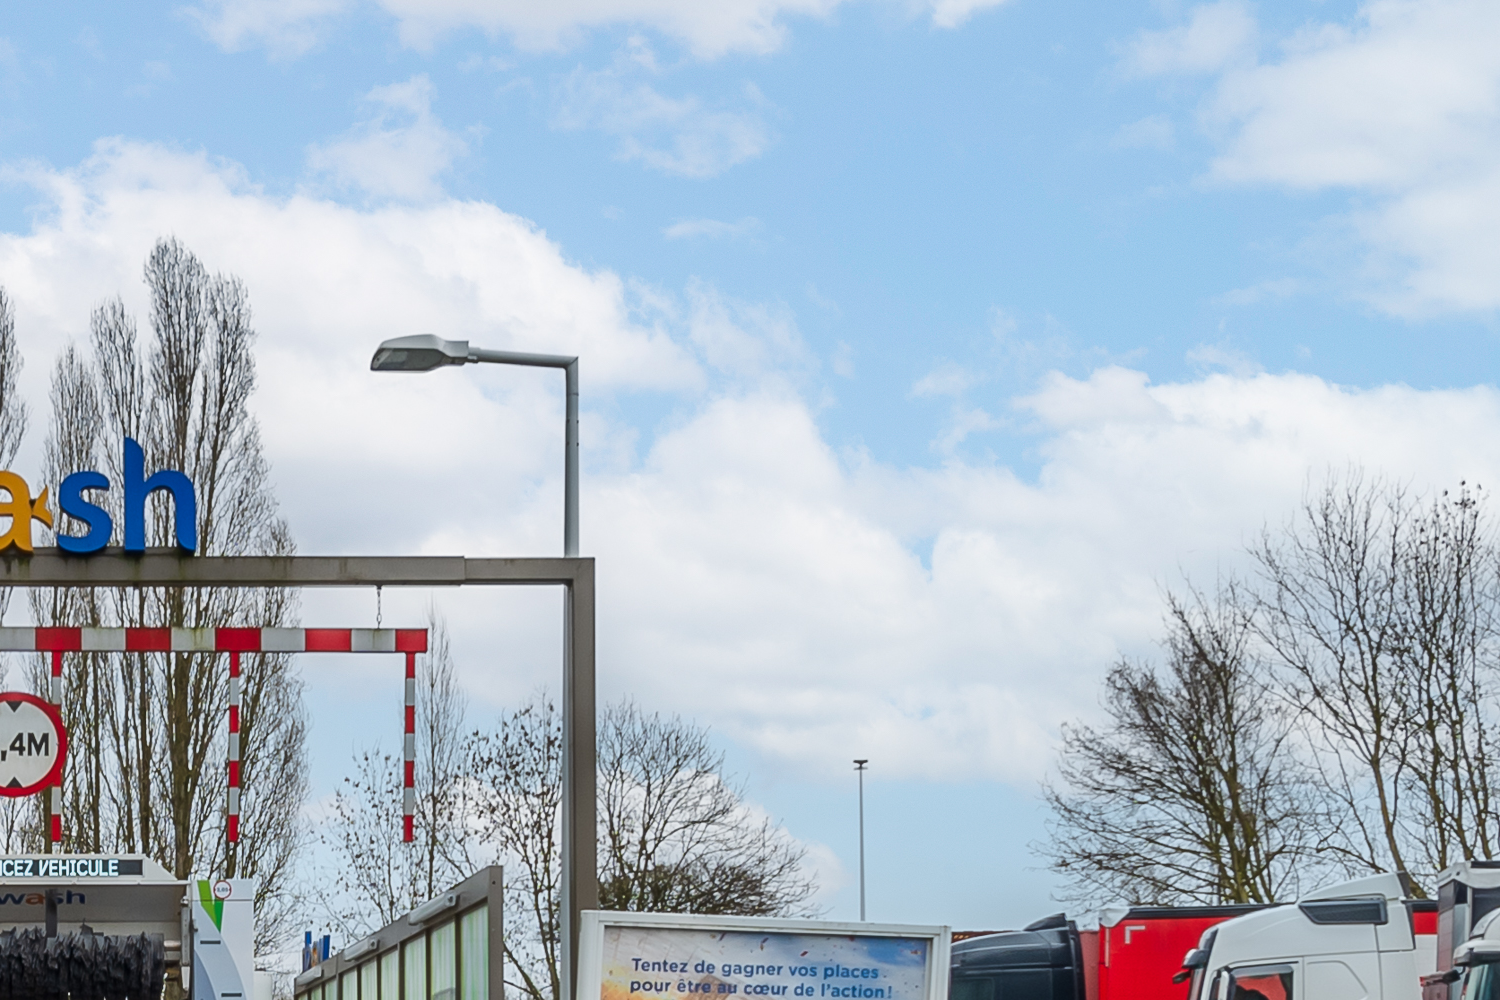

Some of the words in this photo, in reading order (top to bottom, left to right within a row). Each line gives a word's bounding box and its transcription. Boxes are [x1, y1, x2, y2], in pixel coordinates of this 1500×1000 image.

[38, 859, 119, 877] VEHICULE
[631, 957, 689, 973] Tentez
[694, 960, 716, 975] de
[721, 963, 784, 978] gagner
[788, 965, 818, 977] vos
[823, 963, 879, 980] places
[630, 980, 672, 994] pour
[677, 978, 712, 994] être
[717, 982, 738, 995] au
[743, 984, 789, 996] cœur
[793, 982, 815, 997] de
